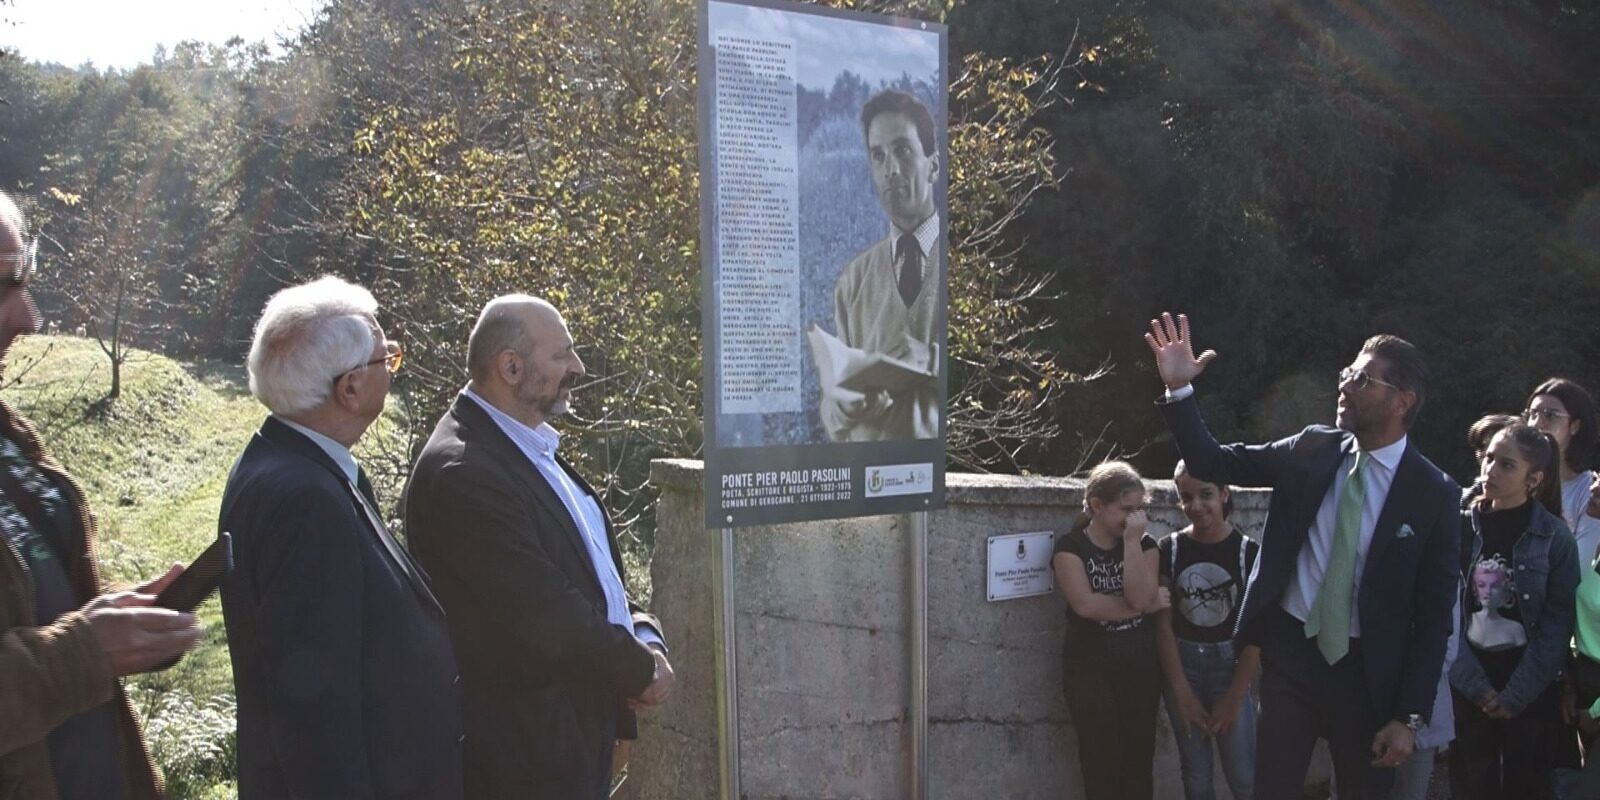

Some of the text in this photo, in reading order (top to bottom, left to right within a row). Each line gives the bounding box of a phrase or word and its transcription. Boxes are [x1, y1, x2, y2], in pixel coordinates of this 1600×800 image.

[762, 41, 791, 49] SCRITTORE
[718, 52, 744, 60] CANTORE
[752, 47, 778, 56] PASOLINI,
[765, 72, 793, 81] CALABRIA,
[719, 83, 759, 93] INTIMAMENTE,
[742, 94, 778, 102] CONFERENZA
[736, 117, 764, 125] VALENTIA,
[720, 139, 756, 148] GEROCARNE,
[722, 468, 851, 488] PONTE PIER PAOLO PASOLINI
[747, 487, 780, 497] SCRITTORE
[789, 484, 813, 494] REGISTA
[821, 483, 851, 491] 1922-1975
[722, 499, 748, 509] COMUNE
[759, 497, 794, 506] GEROCARNE
[810, 493, 835, 502] OTTOBRE
[837, 492, 851, 500] 2022
[1092, 575, 1122, 589] CHEES
